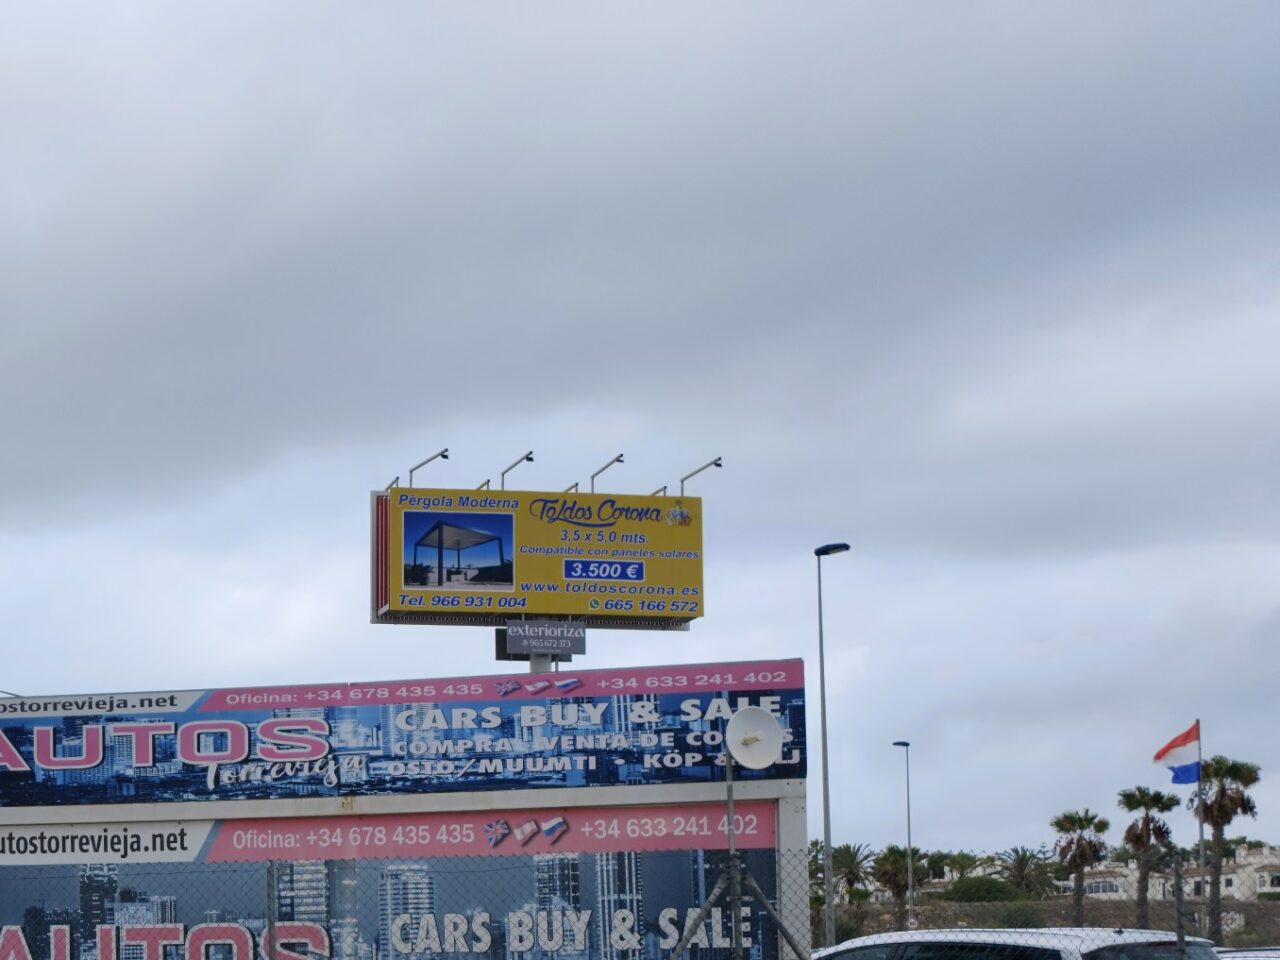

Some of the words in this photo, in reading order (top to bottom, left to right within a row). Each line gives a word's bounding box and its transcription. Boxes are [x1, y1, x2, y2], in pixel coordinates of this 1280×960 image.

[399, 493, 453, 510] Pérgola
[458, 496, 520, 509] Moderna
[529, 498, 595, 526] Toldos
[597, 498, 663, 522] Corona
[560, 529, 580, 543] 3,5
[584, 532, 592, 542] x
[596, 530, 617, 543] 5,0
[621, 532, 649, 544] mts.
[519, 545, 584, 556] Compatible
[587, 548, 608, 556] con
[611, 548, 655, 559] paneles
[658, 549, 699, 559] solares
[570, 562, 621, 578] 3.500
[626, 564, 639, 578] €
[520, 582, 700, 596] www.toldoscorona.es
[398, 594, 426, 607] Tel.
[431, 595, 461, 607] 966
[464, 596, 493, 607] 931
[498, 597, 528, 608] 004
[604, 599, 633, 611] 665
[639, 600, 666, 611] 166
[670, 601, 699, 612] 572
[508, 624, 585, 638] exterioriza
[226, 693, 298, 705] Oficina:
[304, 689, 344, 701] +34
[349, 688, 390, 700] 678
[395, 685, 436, 698] 435
[442, 684, 483, 696] 435
[597, 677, 639, 689] +34
[645, 675, 688, 688] 633
[694, 673, 737, 686] 241
[743, 672, 787, 684] 402
[395, 706, 502, 731] CARS
[520, 702, 609, 727] BUY
[629, 701, 662, 723] &
[393, 737, 514, 756] COMPRA
[541, 734, 631, 751] VENTA
[640, 732, 675, 747] DE
[686, 728, 794, 747] COS
[644, 749, 703, 769] KÖP
[204, 754, 366, 789] Torrevieja
[232, 829, 300, 849] Oficina:
[306, 828, 343, 847] +34
[348, 826, 386, 846] 678
[392, 825, 430, 844] 435
[436, 823, 475, 843] 435
[581, 819, 621, 839] +34
[626, 817, 666, 838] 633
[673, 816, 712, 836] 241
[717, 814, 757, 835] 402
[391, 911, 492, 953] CARS
[508, 909, 593, 952] BUY
[610, 908, 642, 950] &
[658, 906, 753, 950] SALE
